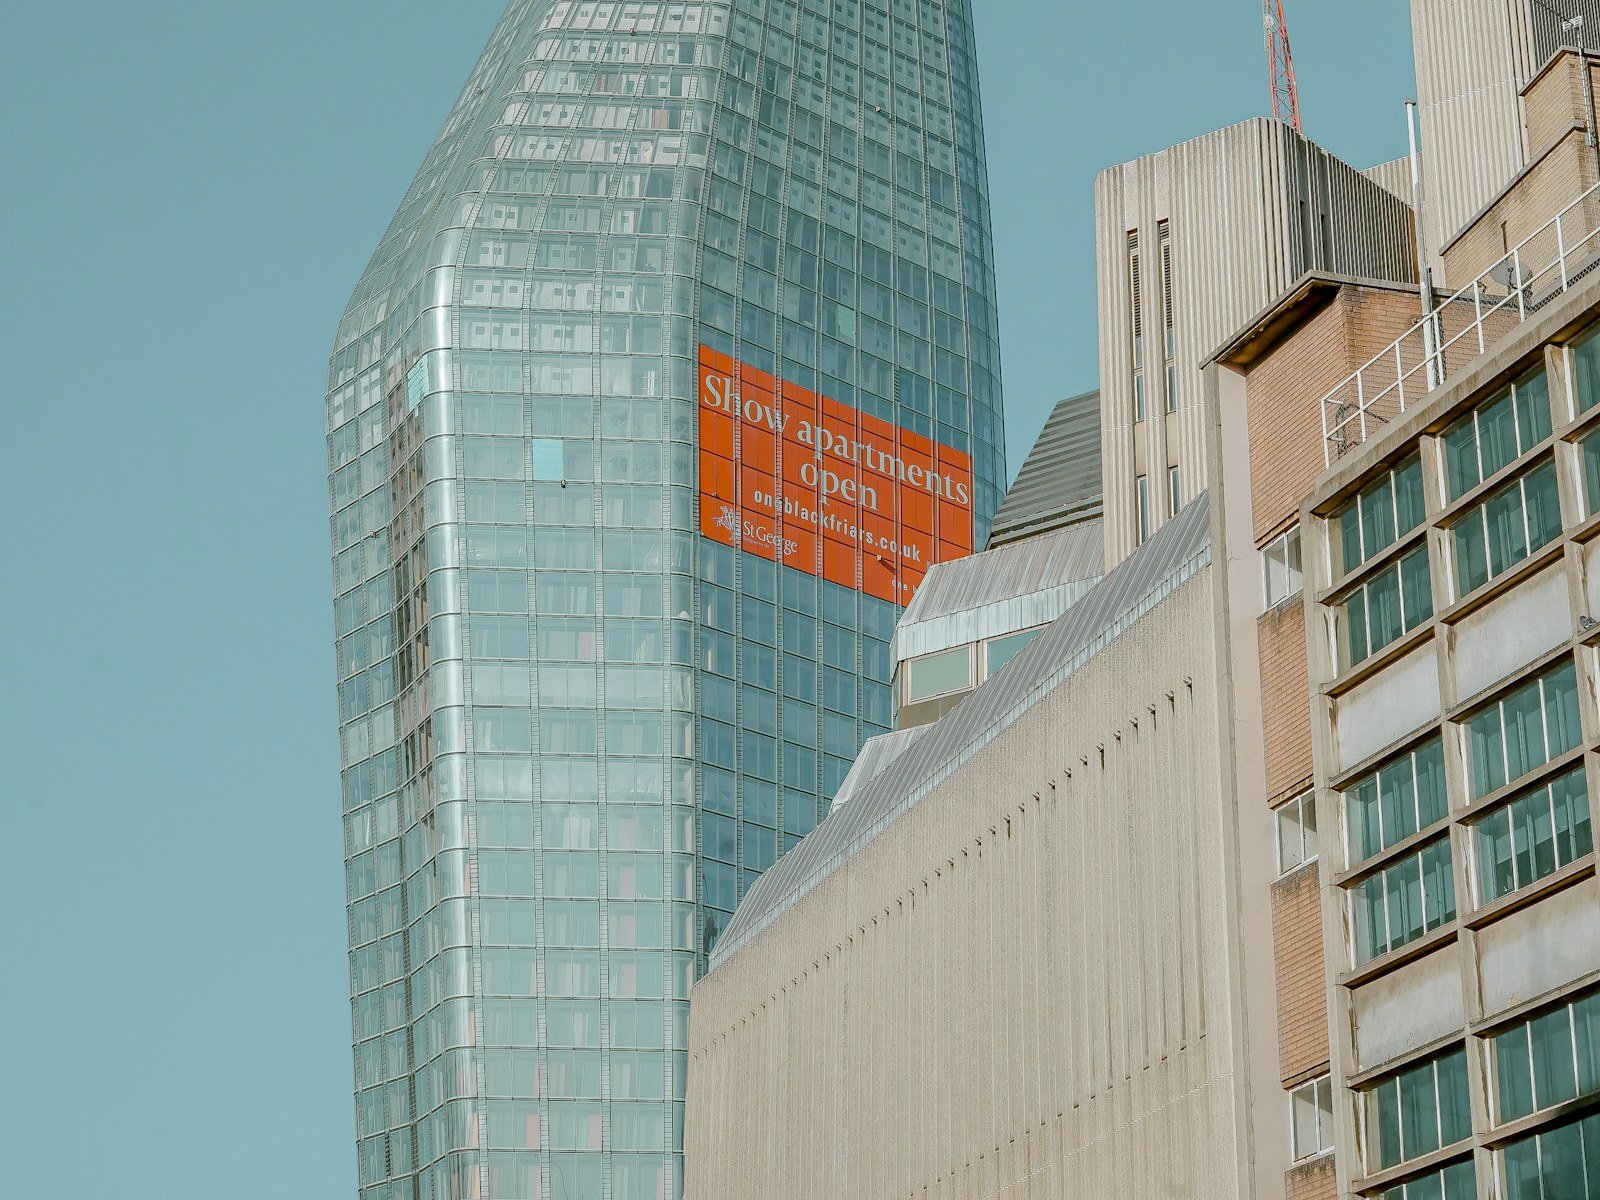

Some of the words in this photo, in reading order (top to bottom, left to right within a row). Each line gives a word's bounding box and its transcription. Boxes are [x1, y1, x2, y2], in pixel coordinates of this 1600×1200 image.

[704, 374, 791, 433] Show
[796, 420, 969, 505] apartments
[800, 462, 879, 511] open
[743, 520, 755, 538] St
[756, 526, 798, 556] George
[891, 579, 908, 591] one
